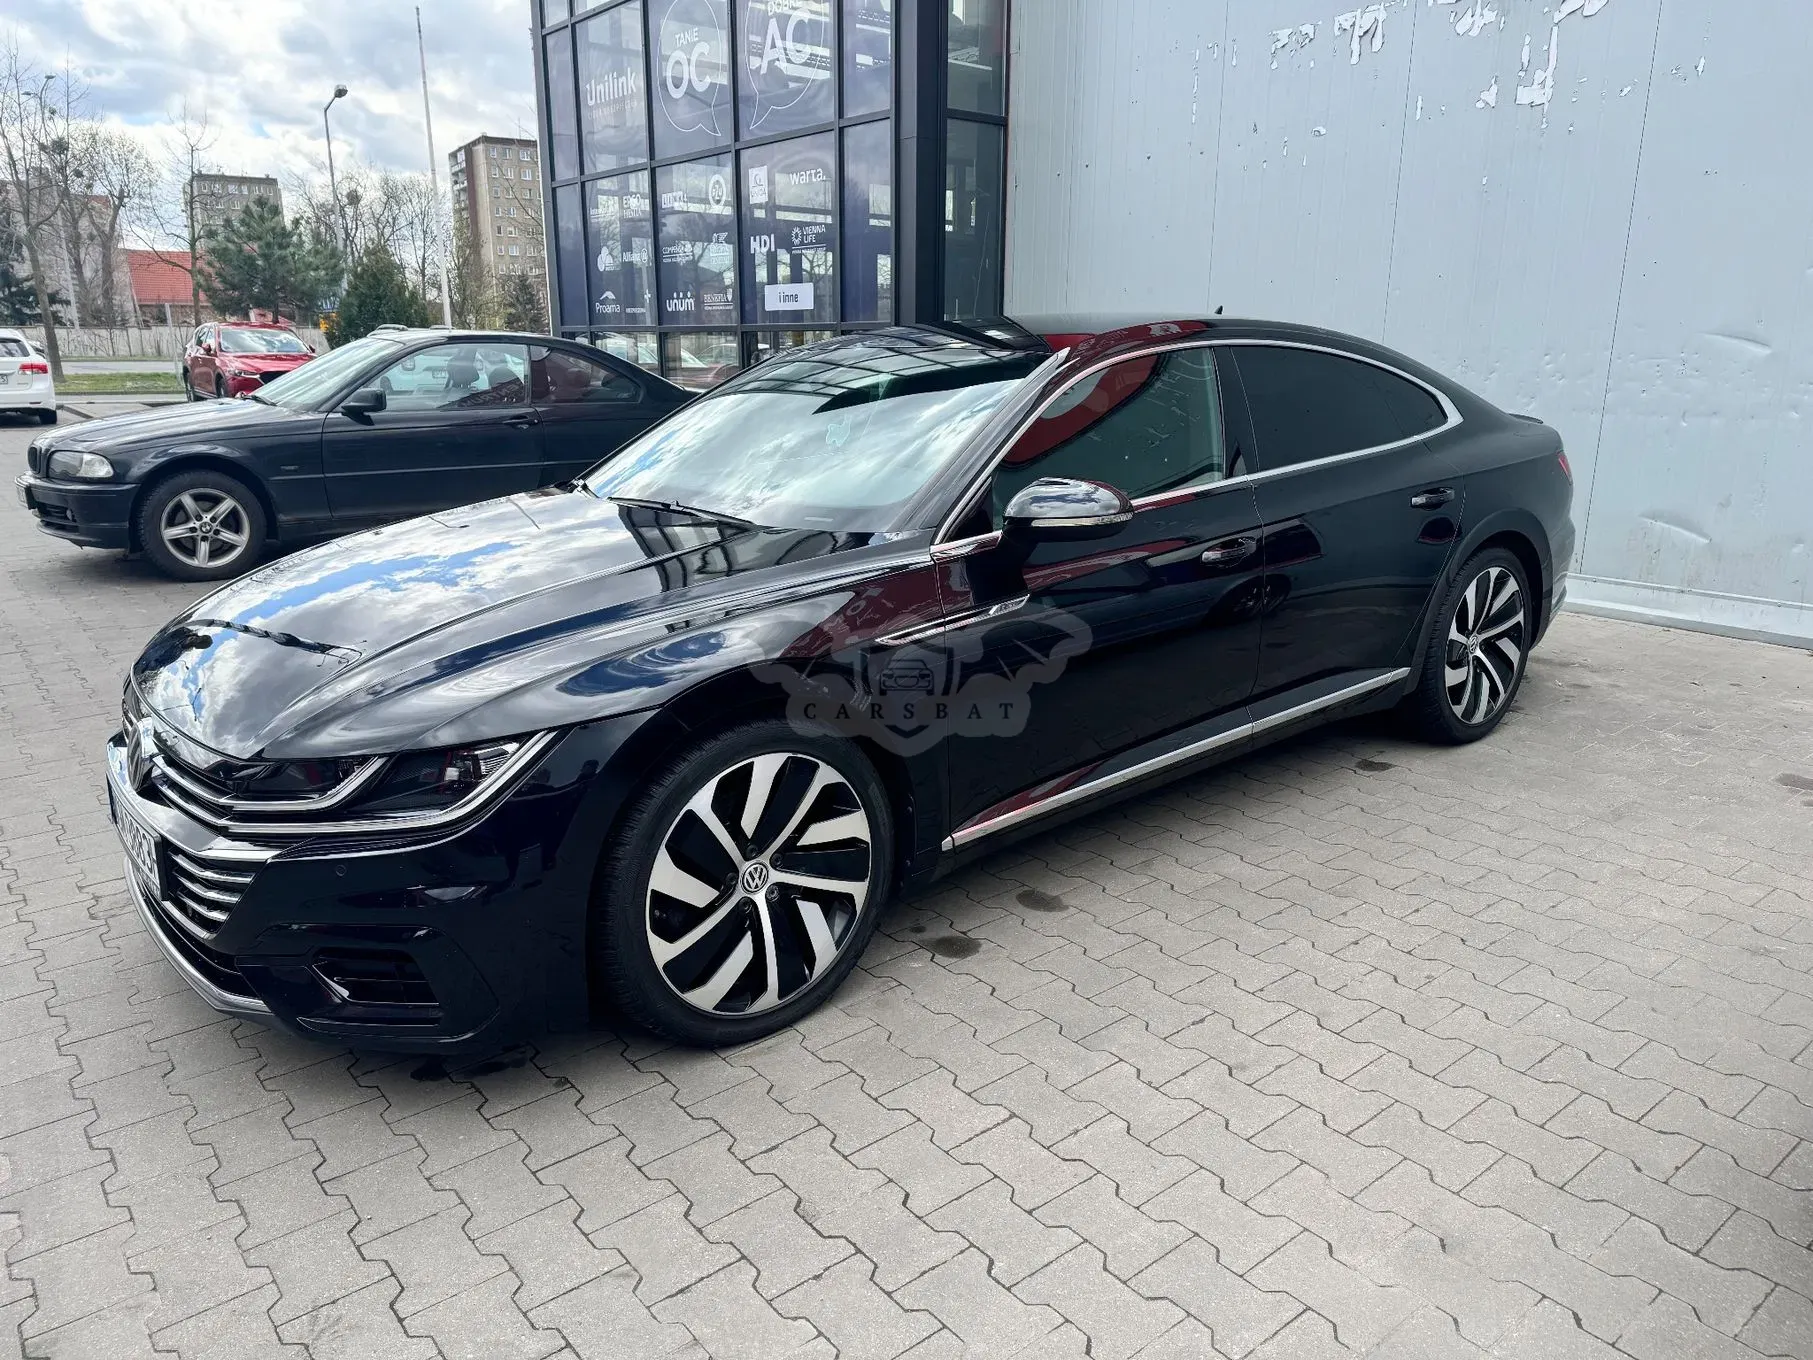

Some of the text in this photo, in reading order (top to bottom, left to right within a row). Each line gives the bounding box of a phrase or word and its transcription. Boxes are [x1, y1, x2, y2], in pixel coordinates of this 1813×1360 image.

[675, 27, 699, 48] TANIE
[760, 7, 812, 75] AC
[666, 41, 711, 99] OC
[585, 67, 637, 106] Unilink
[802, 224, 826, 236] VIENNA
[803, 234, 816, 245] LIFE
[750, 233, 775, 254] HDI
[595, 302, 620, 313] Proama
[782, 292, 799, 303] inne
